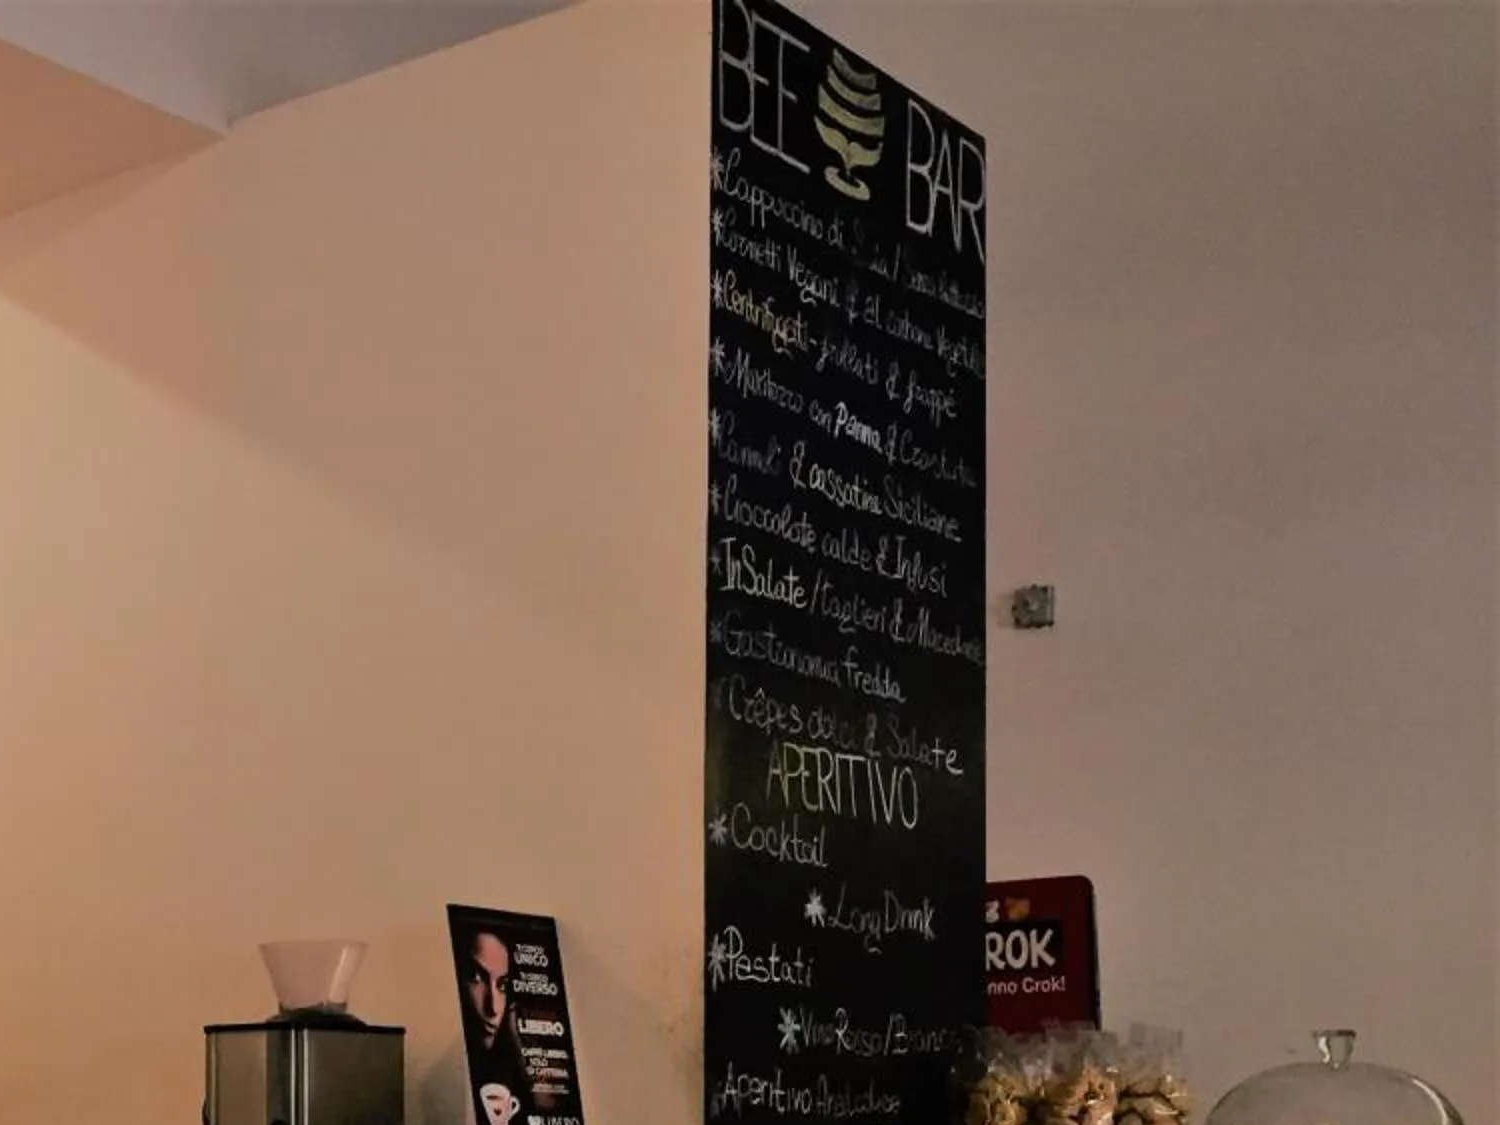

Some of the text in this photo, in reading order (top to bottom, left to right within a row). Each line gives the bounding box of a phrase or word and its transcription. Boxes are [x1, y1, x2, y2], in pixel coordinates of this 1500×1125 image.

[717, 0, 811, 175] BEE
[906, 98, 987, 266] BAR
[766, 741, 919, 830] APERITIVO
[730, 801, 828, 868] Cocktail
[724, 925, 815, 987] Pestati
